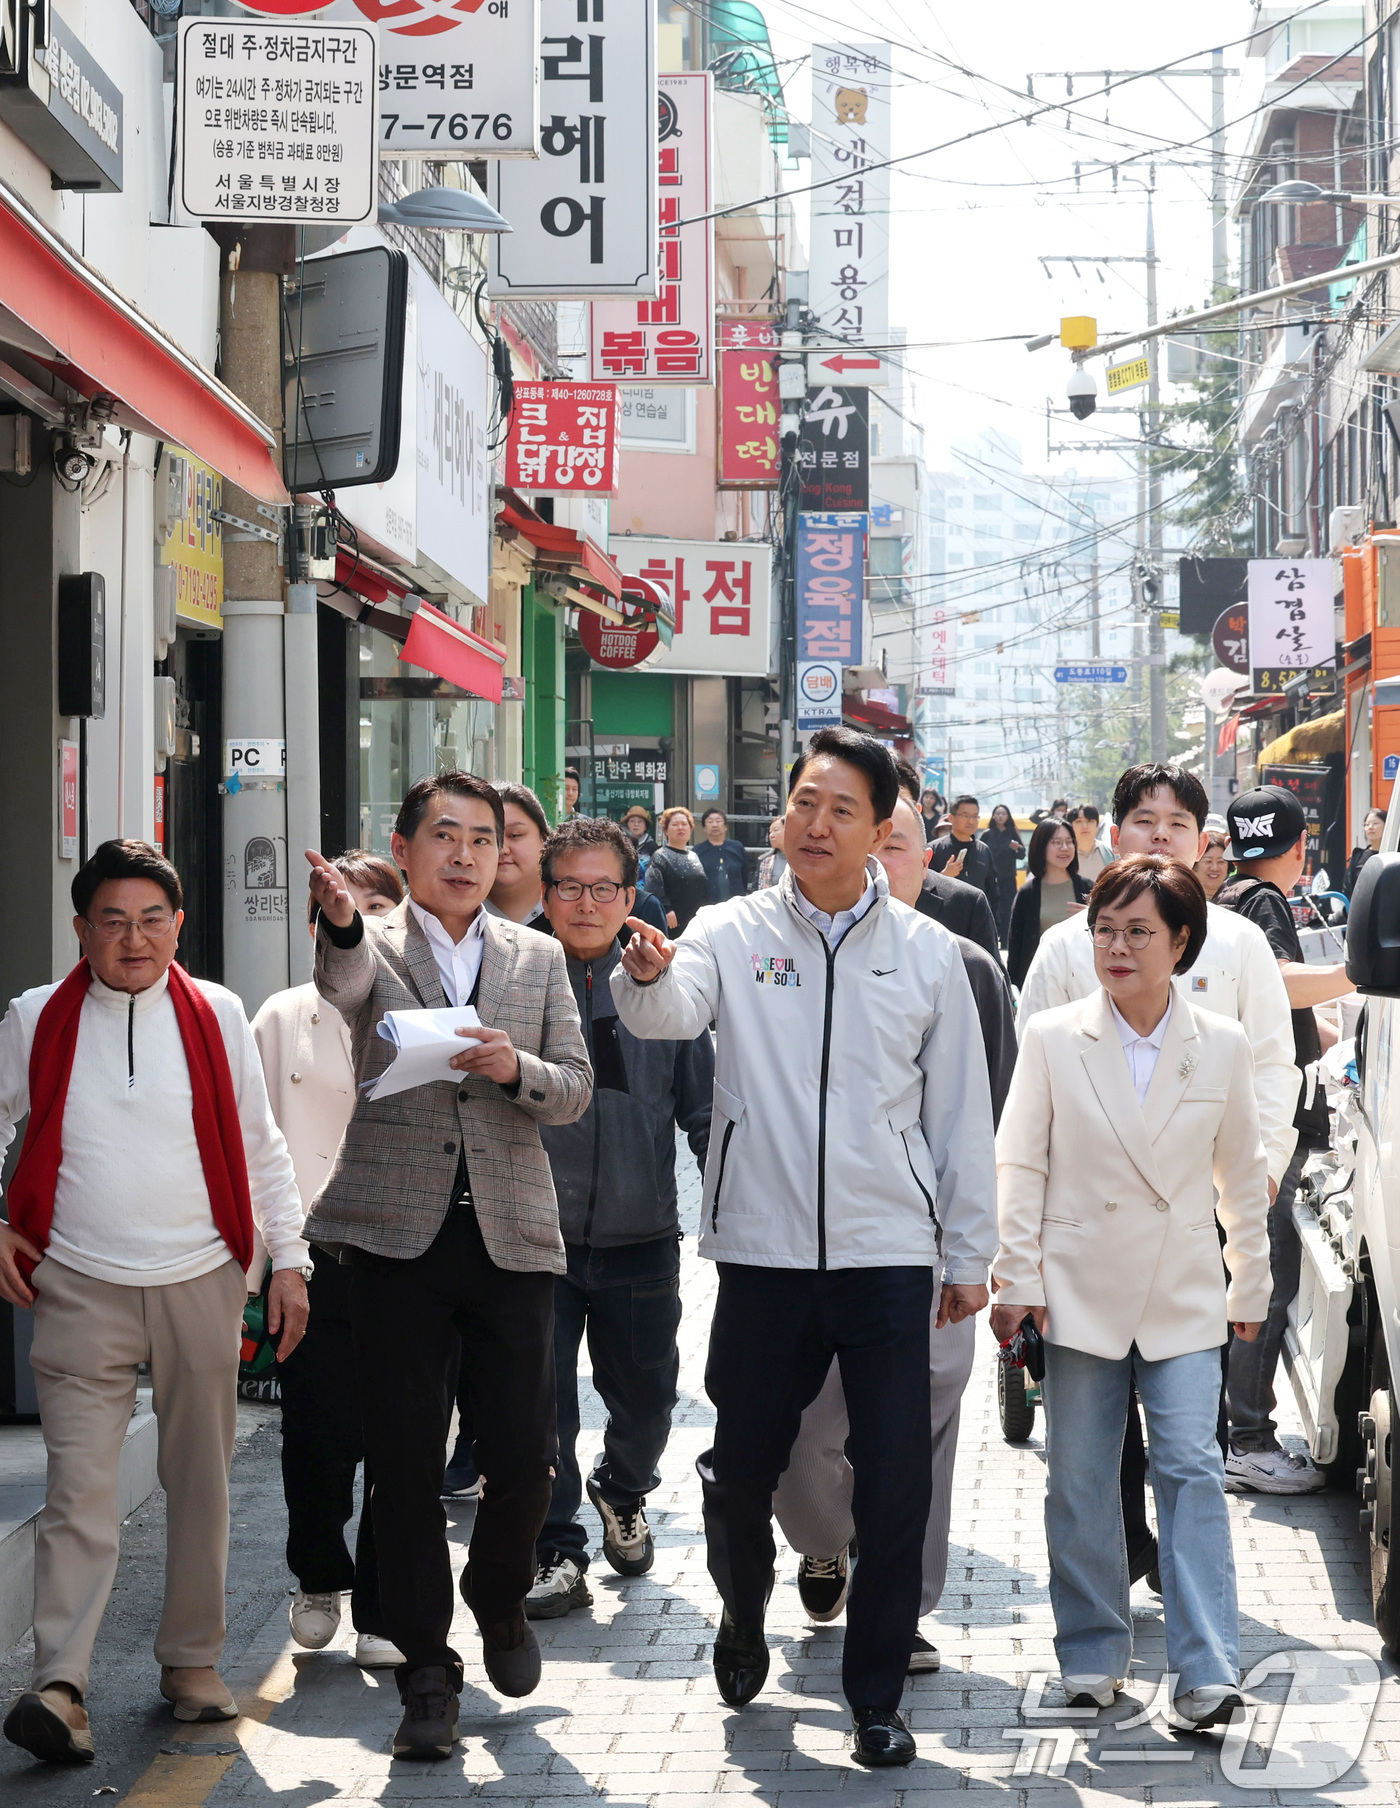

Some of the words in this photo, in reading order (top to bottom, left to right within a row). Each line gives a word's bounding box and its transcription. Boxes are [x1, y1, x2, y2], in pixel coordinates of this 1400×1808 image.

[202, 33, 234, 59] 절대
[241, 34, 357, 63] 주·정차금지구간
[824, 55, 881, 76] 행복한
[196, 75, 223, 99] 여기는
[226, 77, 256, 100] 24시간
[305, 79, 341, 103] 금지되는
[343, 81, 363, 104] 구간
[204, 109, 222, 128] 으로
[224, 107, 268, 131] 위반차량은
[271, 109, 288, 132] 즉시
[291, 110, 337, 134] 단속됩니다.
[212, 138, 234, 158] (승용
[236, 140, 254, 159] 기준
[258, 141, 284, 160] 범칙금
[287, 142, 314, 161] 과태료
[316, 143, 343, 163] 8만원)
[214, 193, 340, 213] 서울지방경찰청장
[515, 386, 545, 400] 상표등록
[636, 402, 668, 419] 연습실
[735, 360, 777, 470] 빈대떡
[433, 370, 475, 516] 세리헤어
[516, 443, 606, 486] 닭강정
[801, 450, 860, 468] 전문점
[825, 482, 852, 496] Kong
[825, 497, 864, 508] Cuisine
[803, 533, 857, 658] 정육점
[1274, 567, 1313, 651] 삼겹살
[601, 634, 637, 647] HOTDOG
[932, 610, 947, 684] 유에스테틱
[600, 646, 636, 659] COFFEE
[806, 675, 832, 689] 담배
[231, 748, 260, 767] PC
[1388, 758, 1396, 768] 16
[634, 761, 667, 780] 백화점
[1233, 812, 1276, 840] PXG
[763, 957, 796, 973] SEOUL
[774, 972, 802, 987] SOUL
